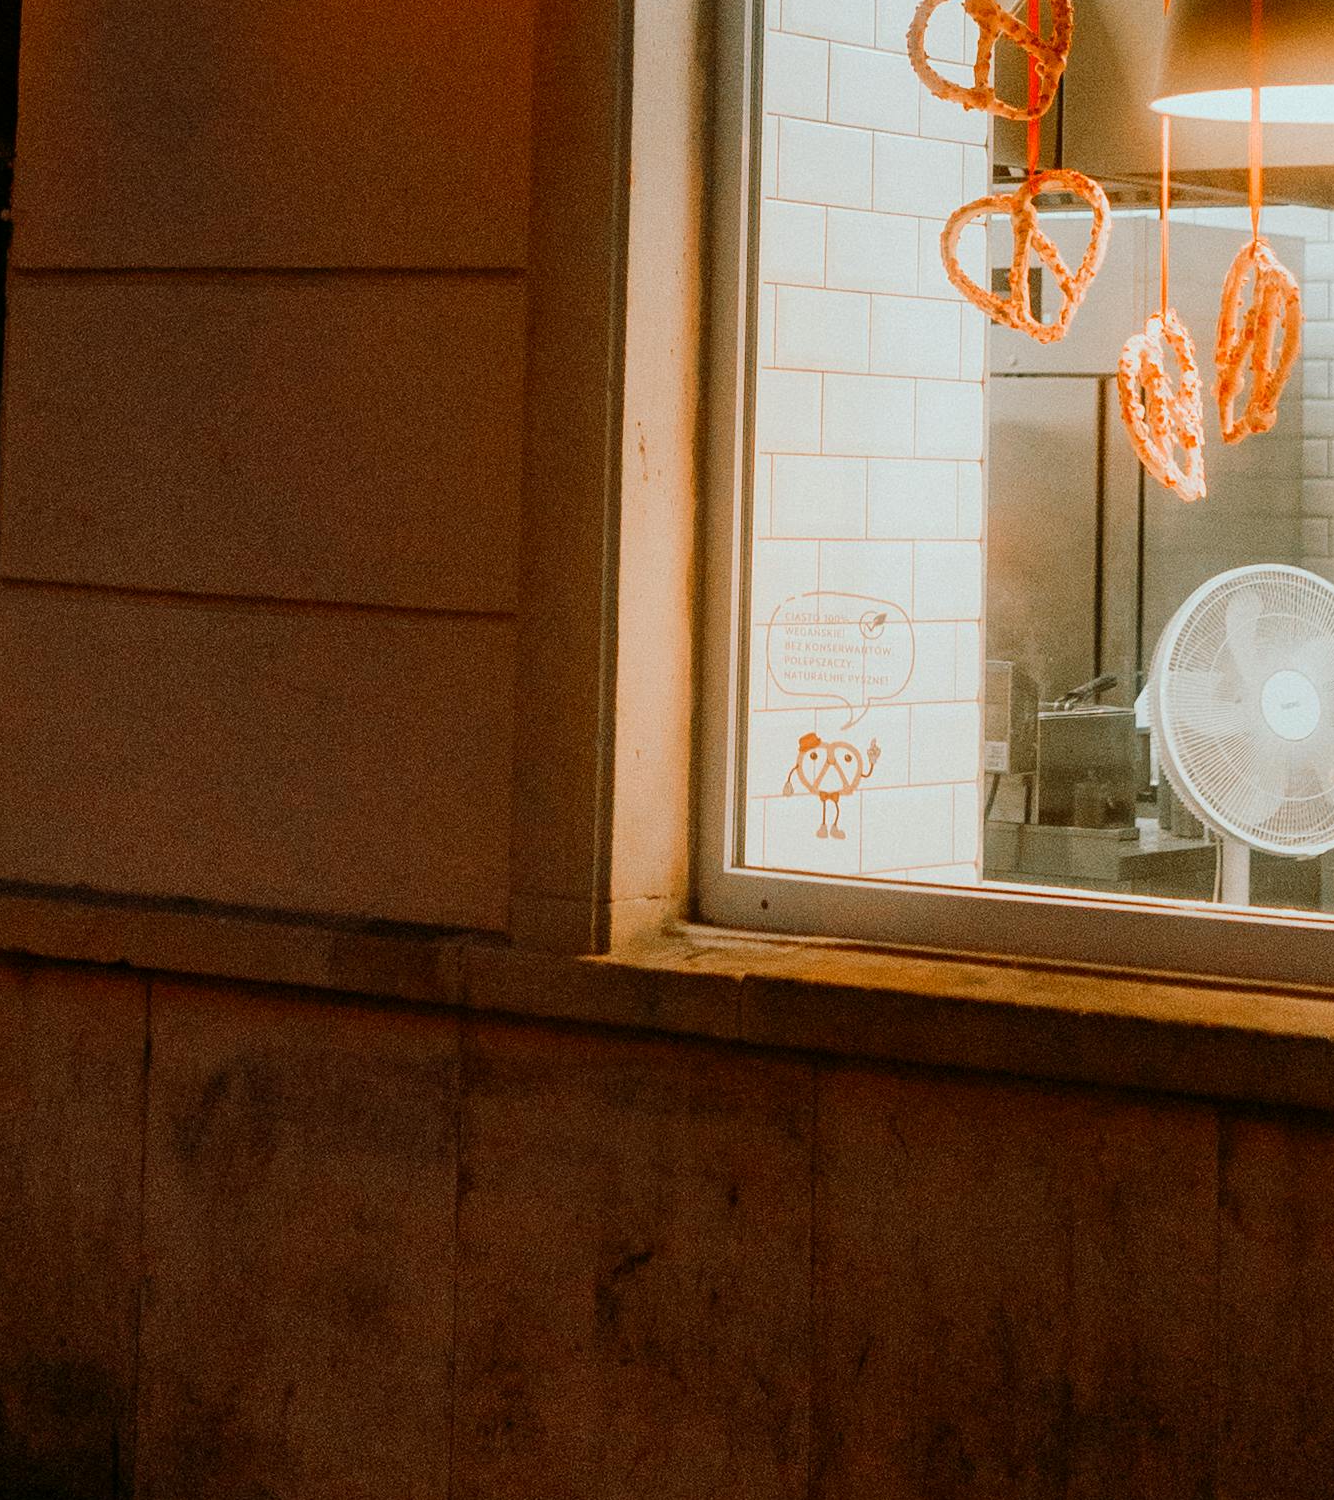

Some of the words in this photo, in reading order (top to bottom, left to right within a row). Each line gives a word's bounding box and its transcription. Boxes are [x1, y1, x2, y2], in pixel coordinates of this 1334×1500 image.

[785, 612, 820, 623] CIASTO
[785, 641, 802, 651] BEZ
[784, 670, 843, 683] NATURALNIE
